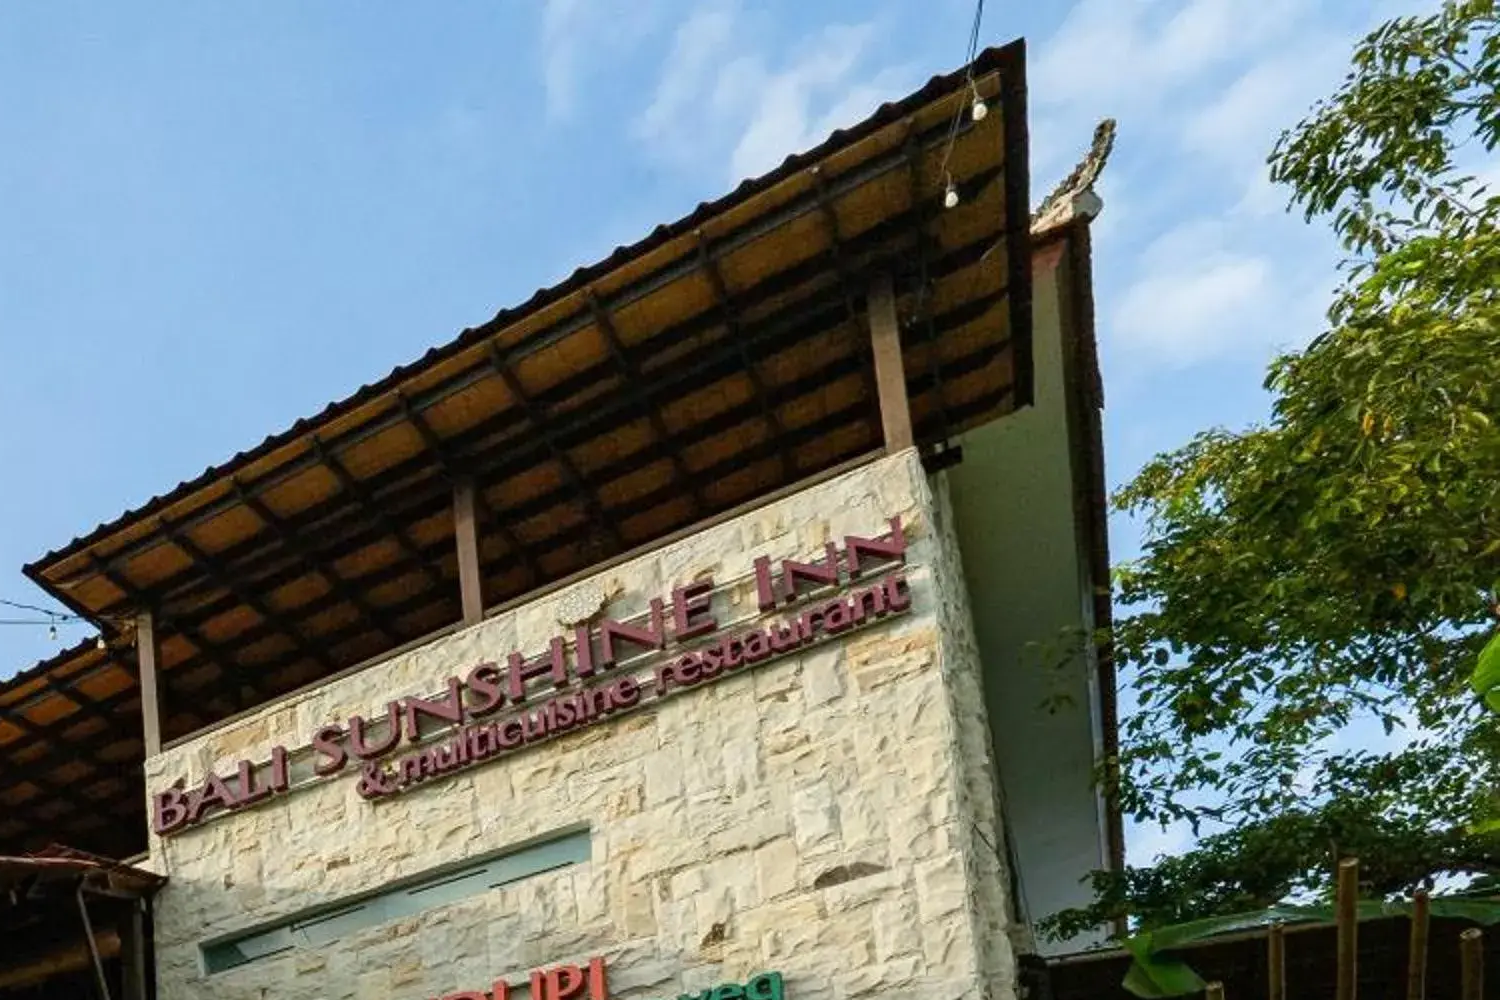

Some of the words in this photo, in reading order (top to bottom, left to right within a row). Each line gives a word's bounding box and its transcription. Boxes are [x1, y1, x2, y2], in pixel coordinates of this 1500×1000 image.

[152, 745, 289, 836] BALI
[312, 577, 718, 777] SUNSHINE
[754, 515, 907, 612] INN
[356, 758, 399, 801] &
[400, 676, 641, 787] multicuisine
[652, 574, 912, 697] restaurant
